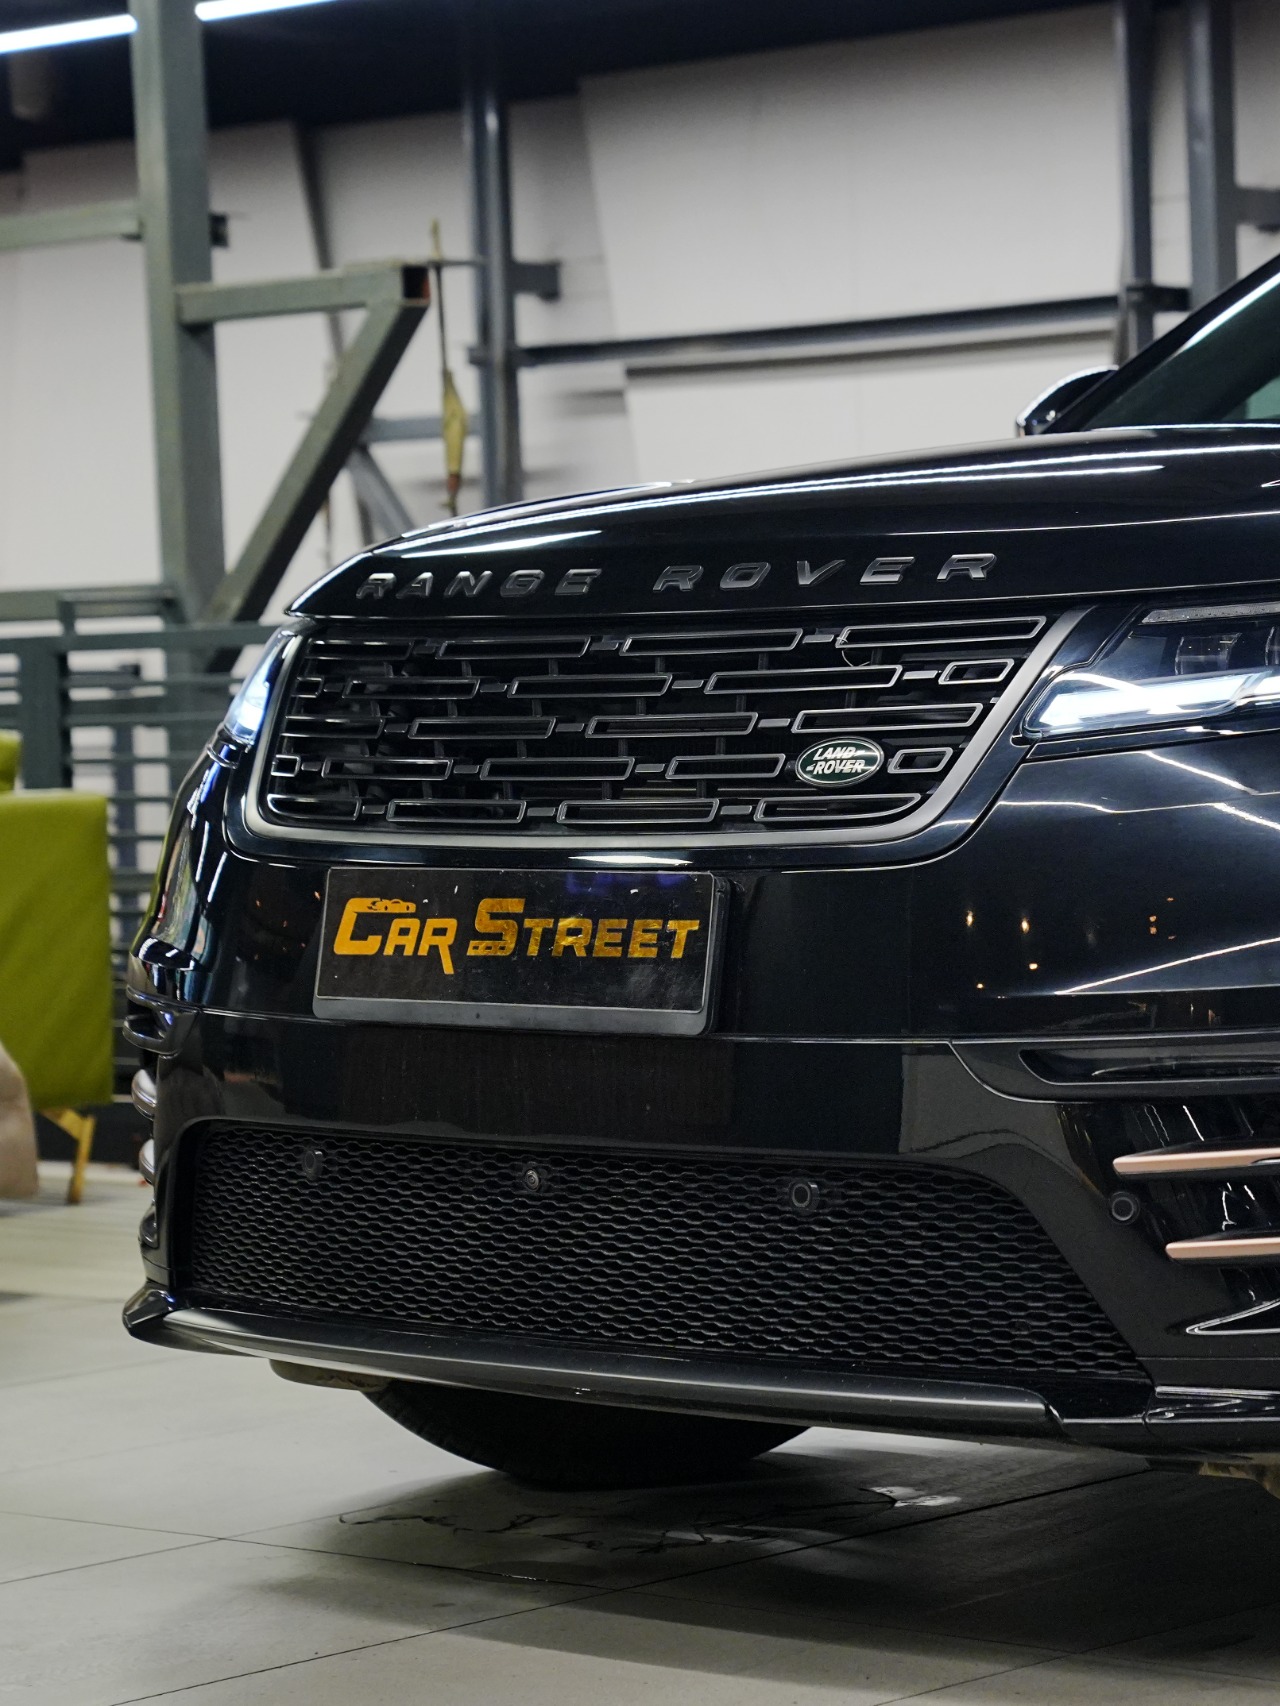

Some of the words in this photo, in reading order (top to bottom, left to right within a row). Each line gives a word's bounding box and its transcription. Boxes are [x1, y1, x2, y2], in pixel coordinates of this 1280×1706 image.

[356, 568, 602, 599] RANGE
[652, 553, 998, 592] ROVER
[812, 746, 857, 761] LAND
[812, 759, 866, 775] ROVER
[333, 897, 458, 975] CAR
[466, 897, 700, 959] STREET
